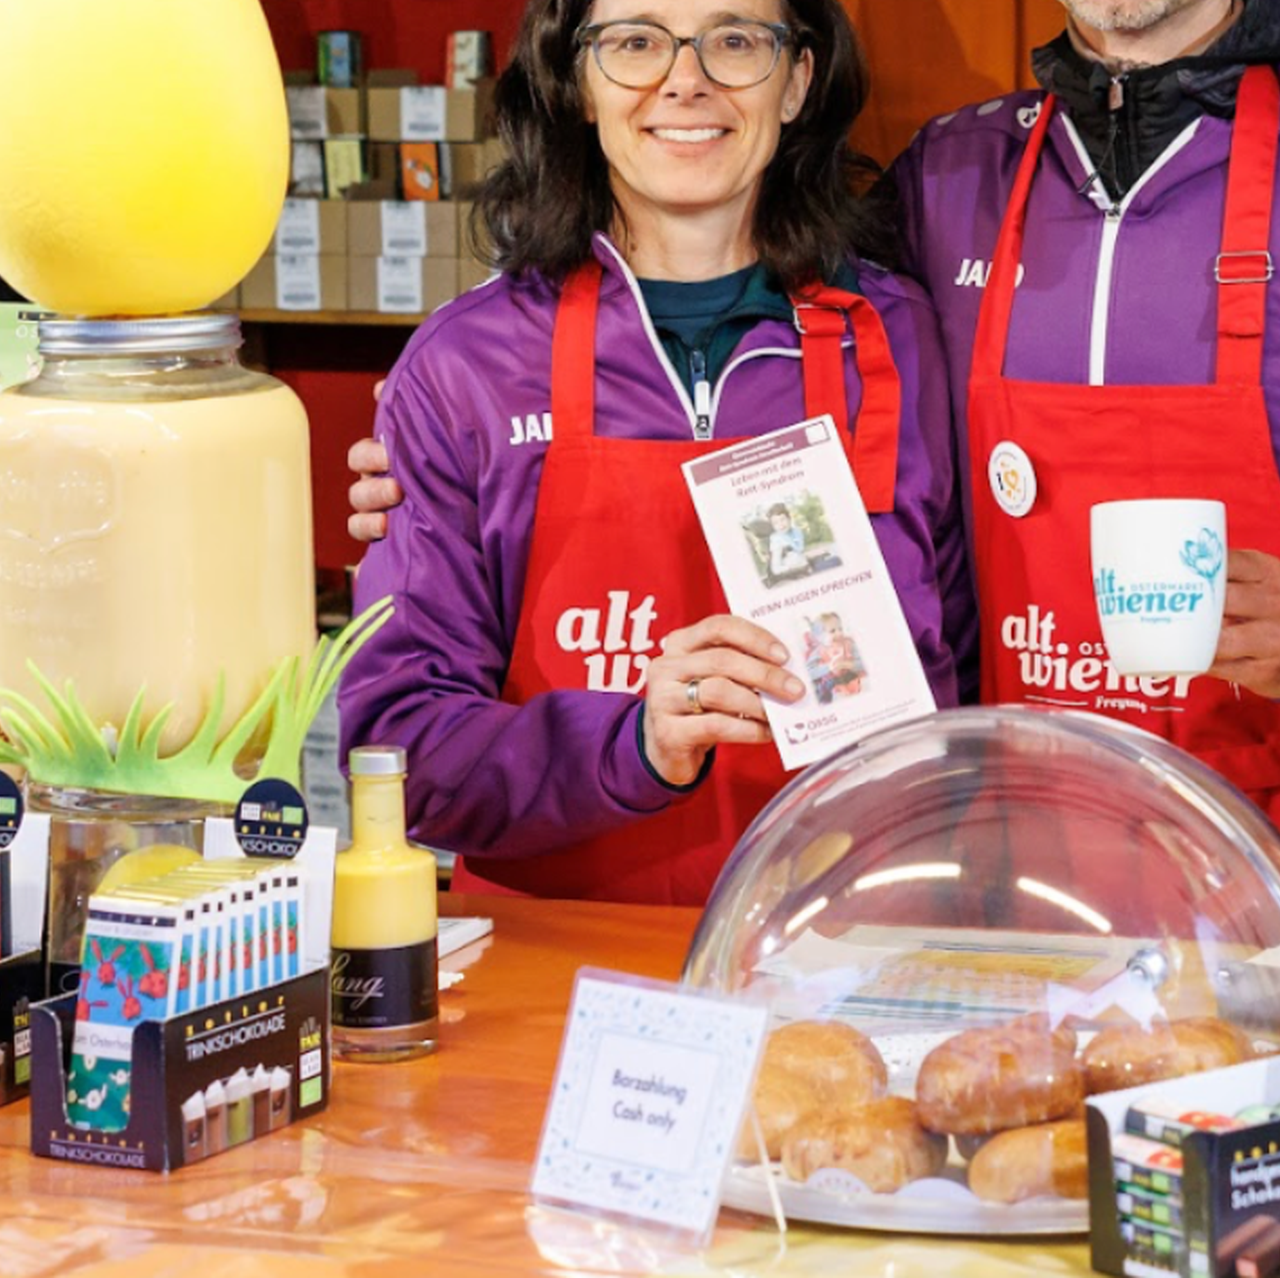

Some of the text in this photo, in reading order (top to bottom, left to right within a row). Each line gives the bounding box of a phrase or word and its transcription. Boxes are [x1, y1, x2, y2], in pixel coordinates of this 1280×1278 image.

[820, 571, 874, 596] SPRECHEN
[1099, 586, 1203, 616] wiener
[185, 1013, 287, 1063] TRINKSCHOKOLADE
[611, 1068, 688, 1104] Barzahlung
[612, 1101, 677, 1134] Cash only
[49, 1142, 146, 1168] TRINKSCHOKOLADE
